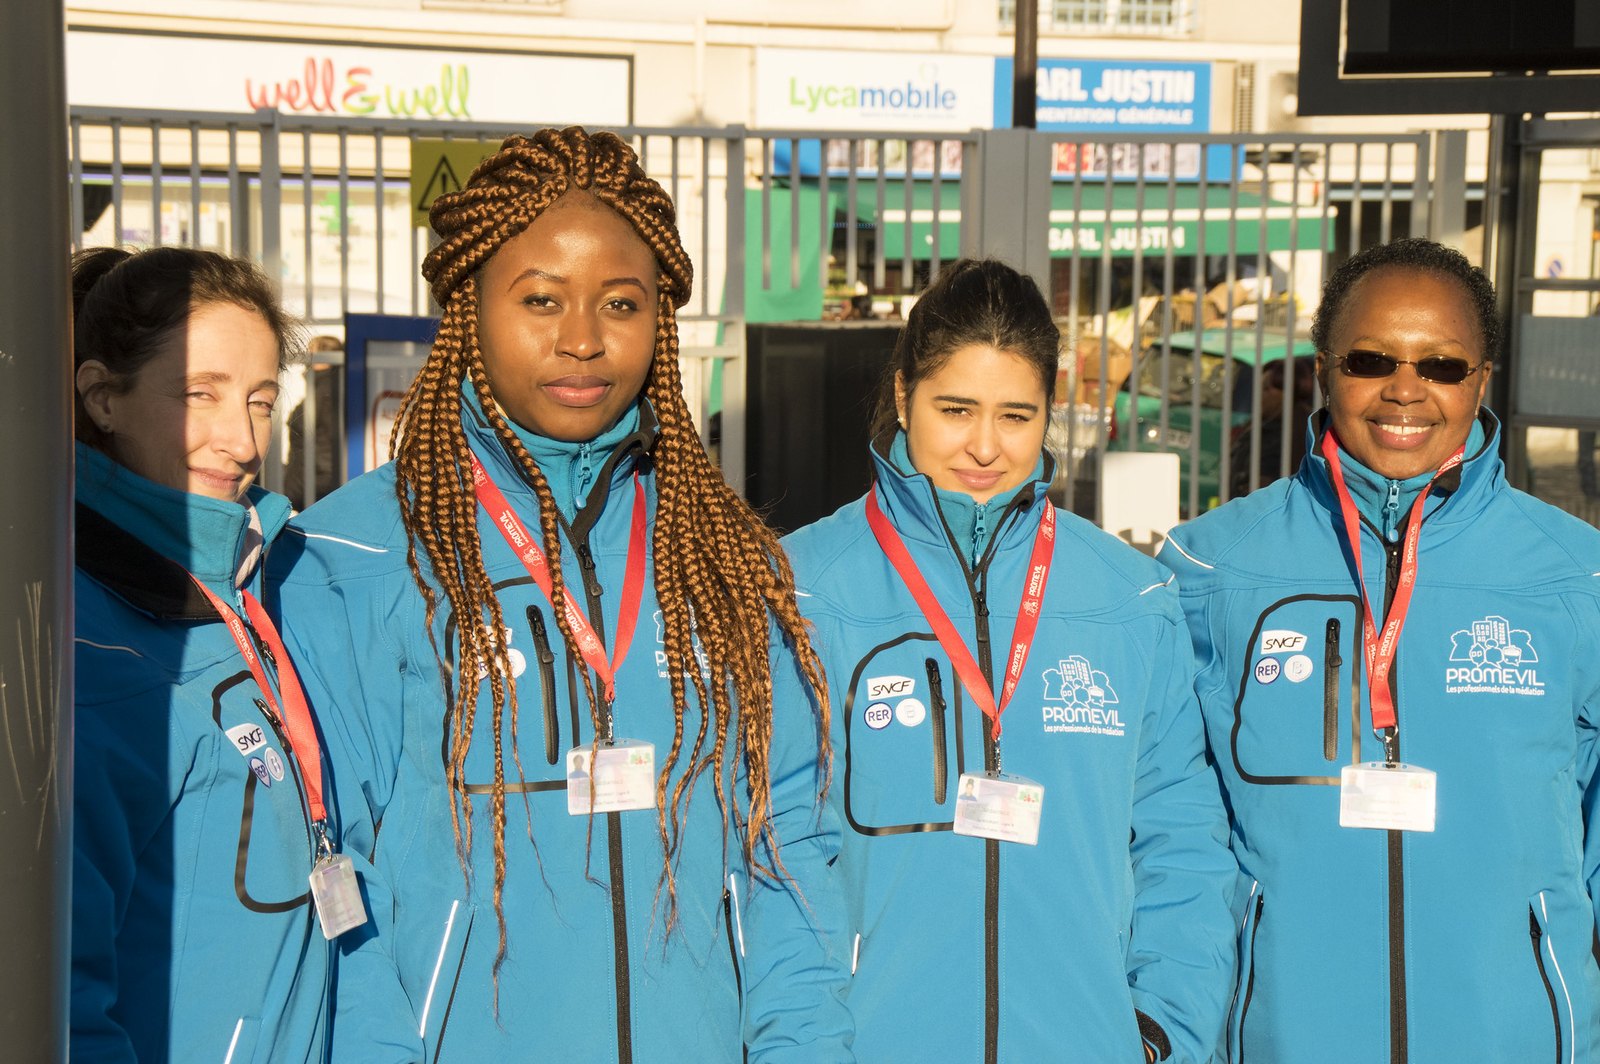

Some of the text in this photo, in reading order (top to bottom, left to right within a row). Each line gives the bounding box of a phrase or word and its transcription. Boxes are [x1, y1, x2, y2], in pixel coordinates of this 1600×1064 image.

[245, 57, 337, 112] well
[385, 63, 471, 117] well
[788, 76, 956, 113] Lycamobile
[1036, 66, 1195, 104] ARL JUSTIN
[500, 511, 526, 547] PROMEVIL
[1263, 636, 1304, 650] SNCF
[1380, 619, 1397, 656] PROMEVIL
[1257, 664, 1278, 677] RER
[1446, 668, 1545, 686] PROMEVIL
[870, 680, 912, 696] SNCF
[1446, 685, 1457, 693] Les
[1457, 684, 1500, 694] professionnels
[1500, 685, 1508, 694] de
[868, 709, 890, 722] RER
[1042, 706, 1125, 726] PROMEVIL
[237, 727, 262, 751] SNCF
